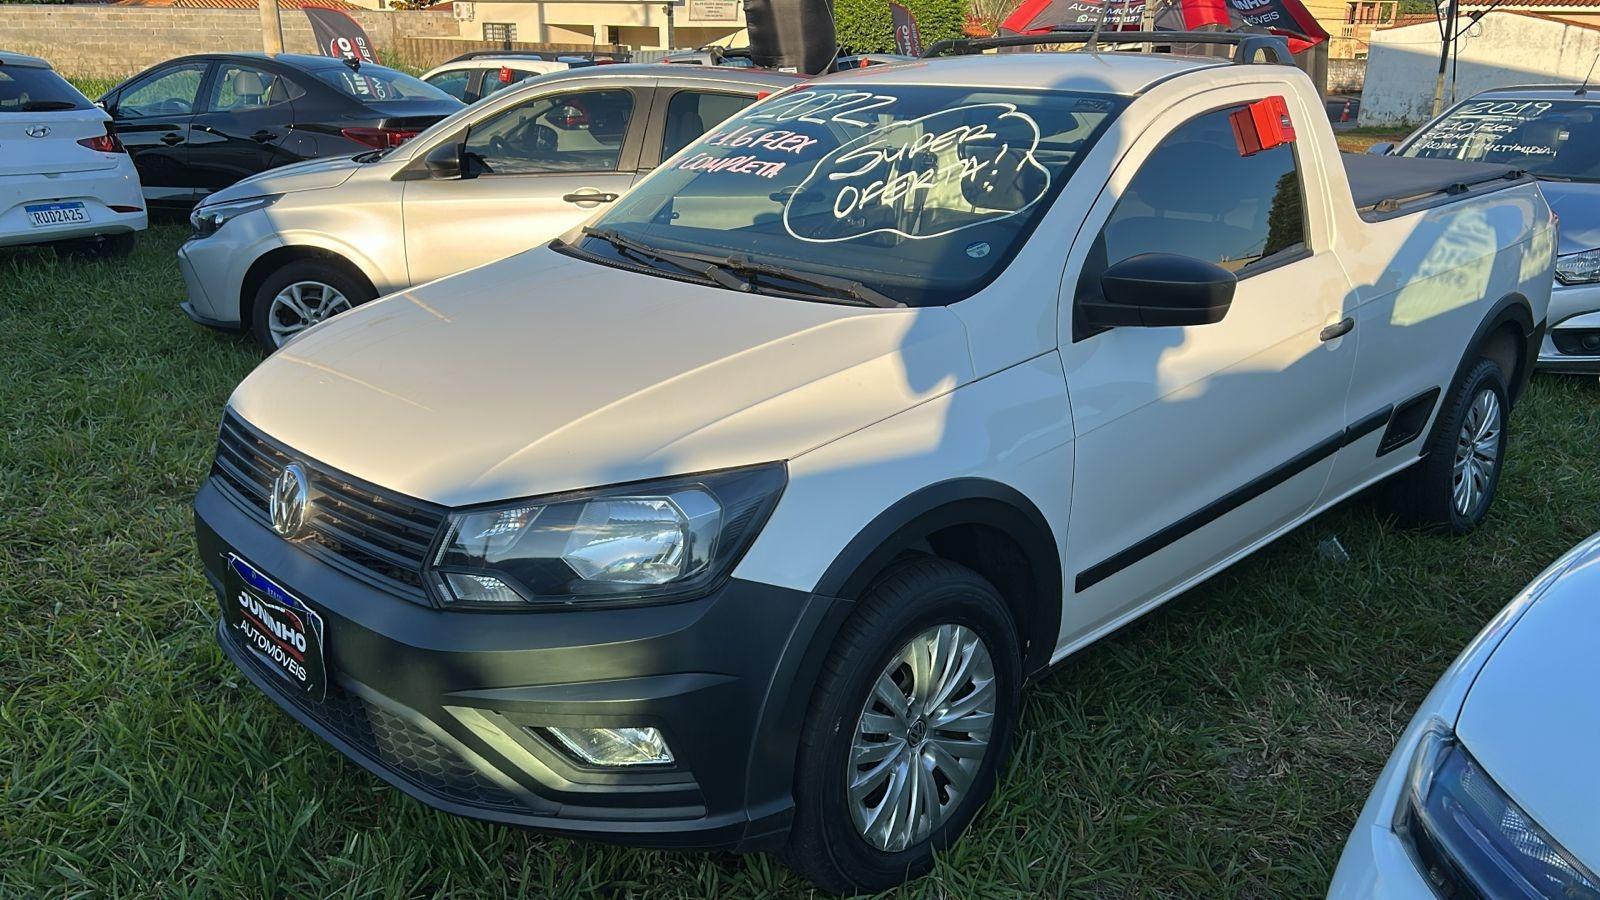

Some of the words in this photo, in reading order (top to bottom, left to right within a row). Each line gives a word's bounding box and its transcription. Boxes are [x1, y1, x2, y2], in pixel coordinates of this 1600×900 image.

[743, 91, 897, 127] 2022
[1458, 101, 1553, 116] 2019
[678, 152, 787, 178] COMPLETA
[829, 124, 997, 180] SUPER
[34, 208, 84, 224] RUD2A25
[238, 591, 307, 653] JUNINHO
[240, 619, 307, 682] AUTOMÓVEIS
